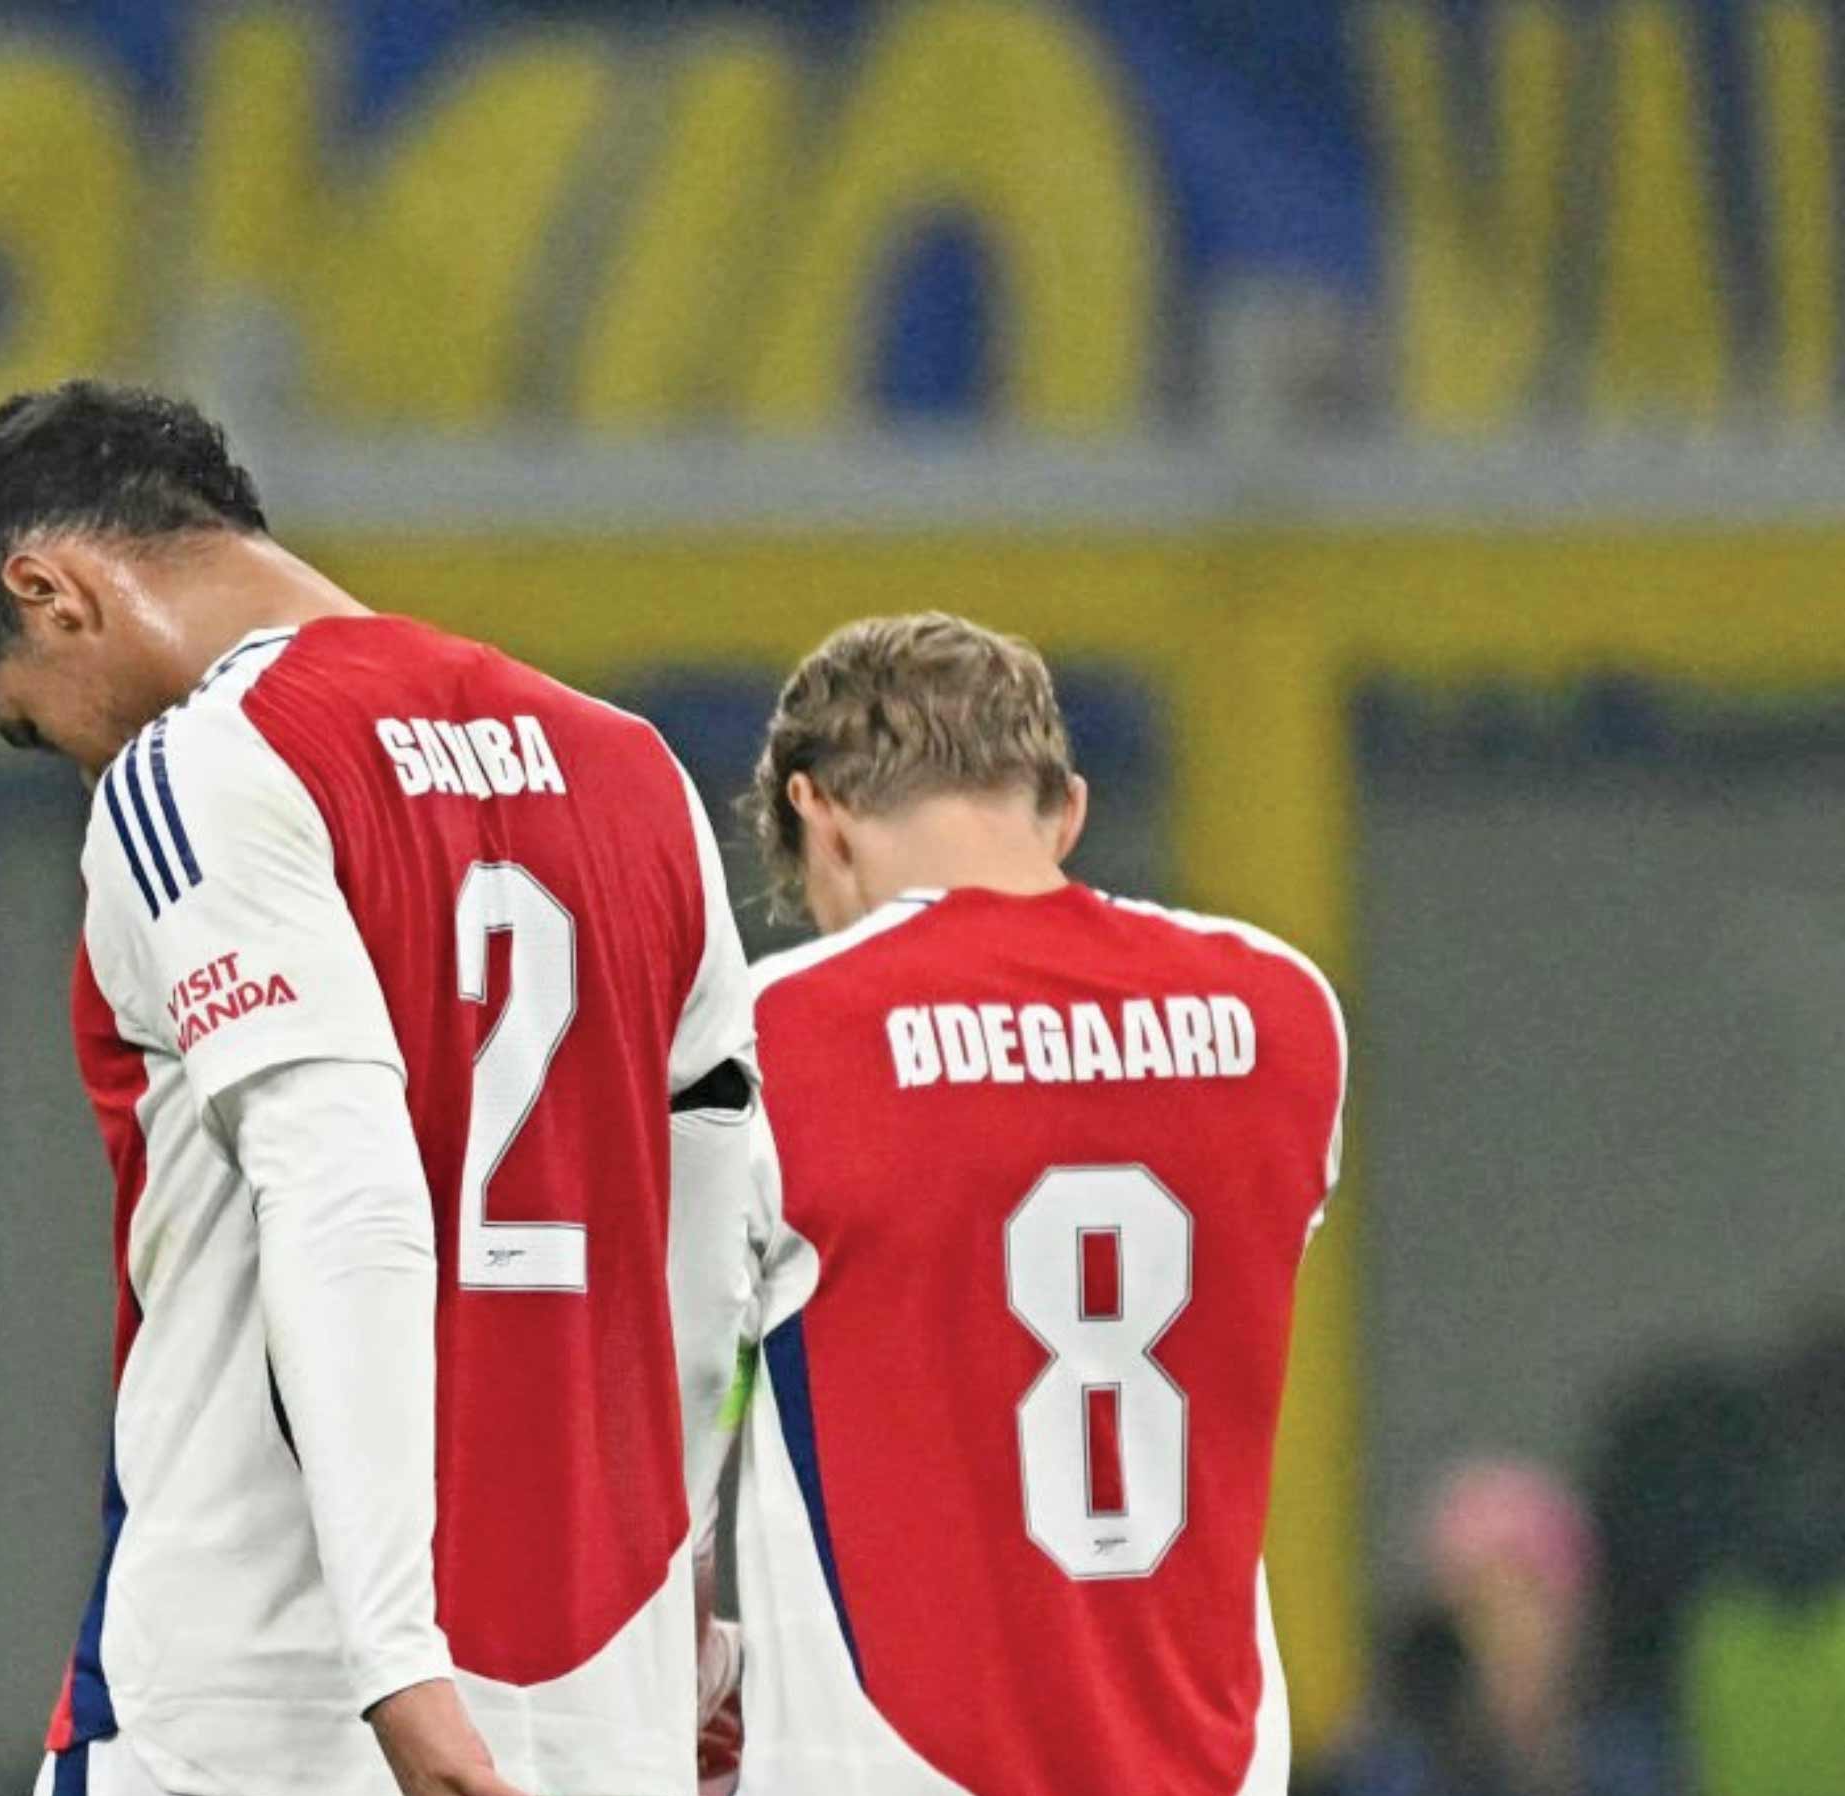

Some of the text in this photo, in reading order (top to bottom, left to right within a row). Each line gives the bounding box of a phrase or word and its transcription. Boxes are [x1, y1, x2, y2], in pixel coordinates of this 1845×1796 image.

[167, 951, 239, 1023] VISIT
[455, 860, 588, 1293] 2
[885, 995, 1257, 1089] ØDEGAARD
[1004, 1163, 1193, 1580] 8
